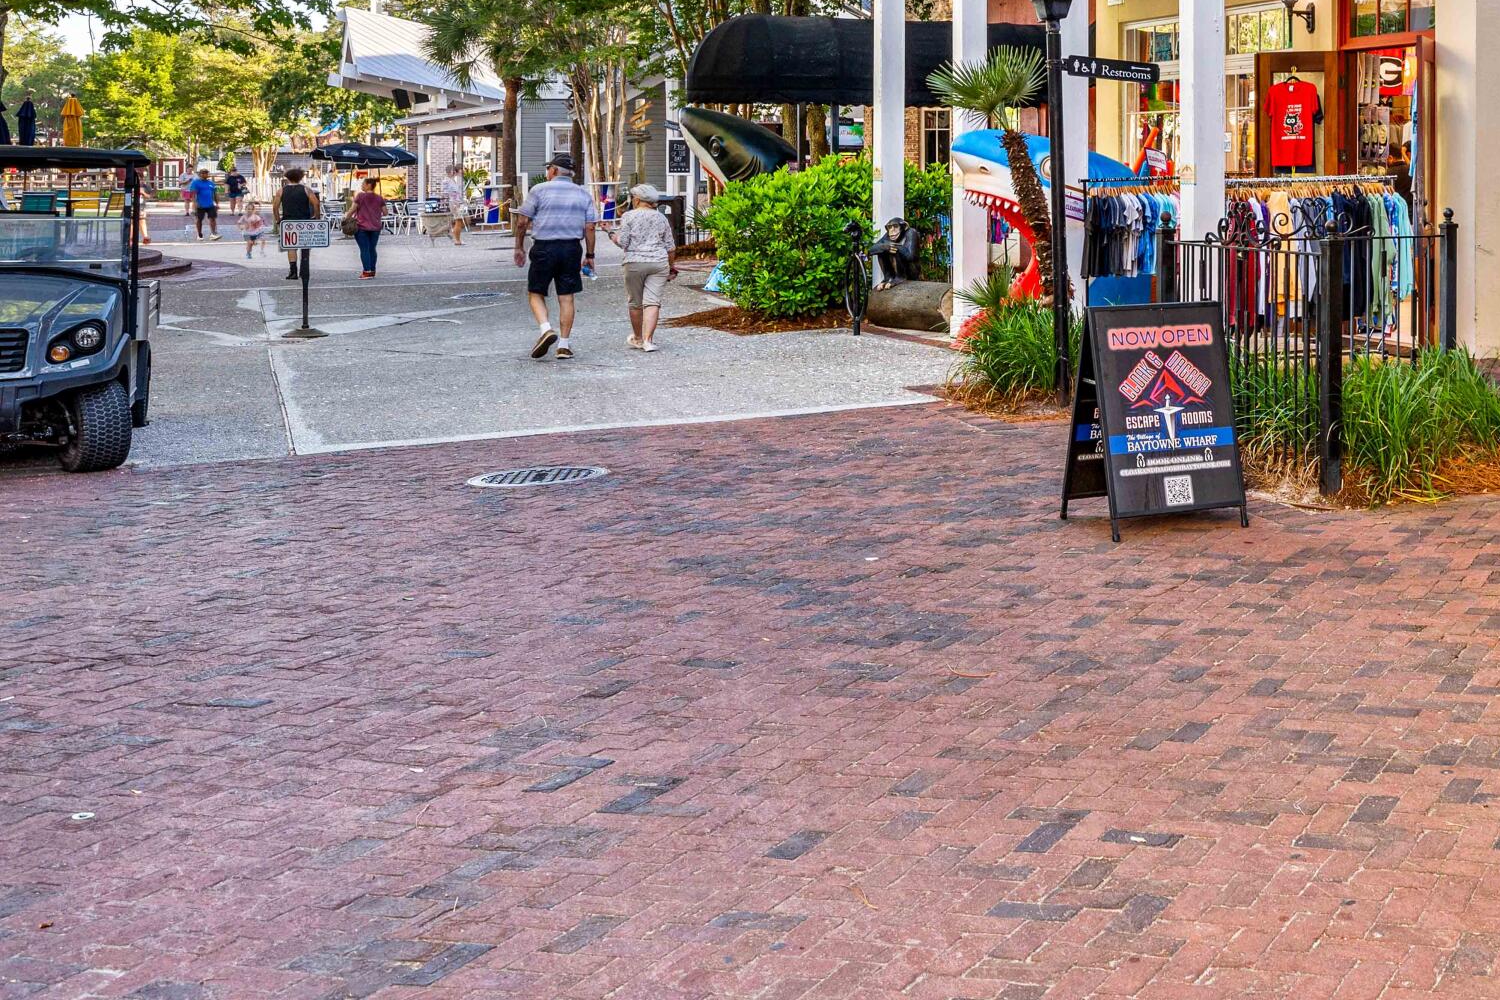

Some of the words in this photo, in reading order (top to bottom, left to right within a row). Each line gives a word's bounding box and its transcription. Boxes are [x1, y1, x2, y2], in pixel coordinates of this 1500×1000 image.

[1102, 64, 1151, 80] Restrooms
[284, 232, 298, 246] NO
[1112, 330, 1156, 346] NOW
[1162, 328, 1208, 343] OPEN
[1119, 358, 1157, 402] CLOAK
[1164, 350, 1212, 397] DAGGER
[1126, 414, 1160, 429] ESCAPE
[1182, 410, 1212, 424] ROOMS
[1127, 438, 1181, 452] BAYTOWNE
[1183, 434, 1217, 447] WHARF
